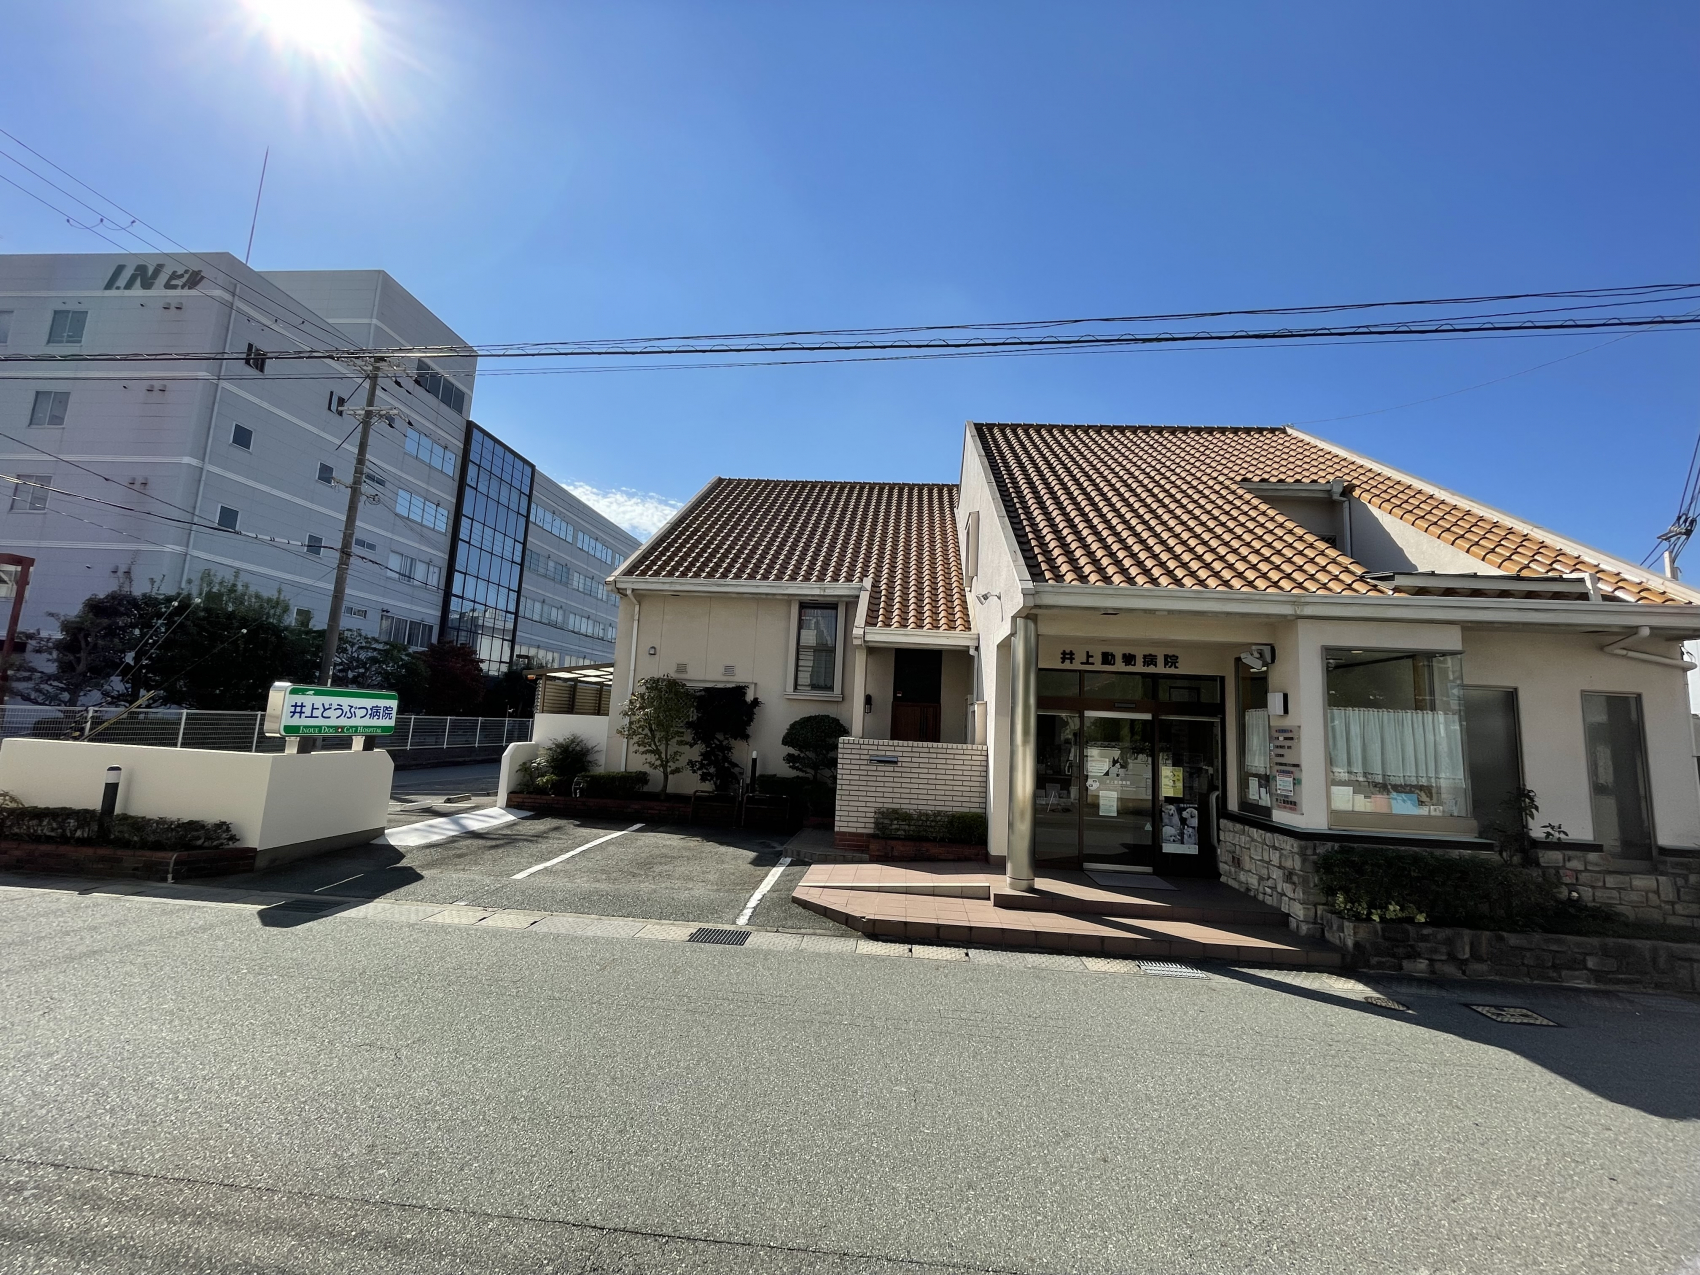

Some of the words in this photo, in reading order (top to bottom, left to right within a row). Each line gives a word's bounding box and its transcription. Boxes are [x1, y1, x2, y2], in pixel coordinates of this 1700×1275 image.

[1060, 650, 1179, 669] 井上動物病院
[289, 702, 394, 721] 井上どうぶつ病院
